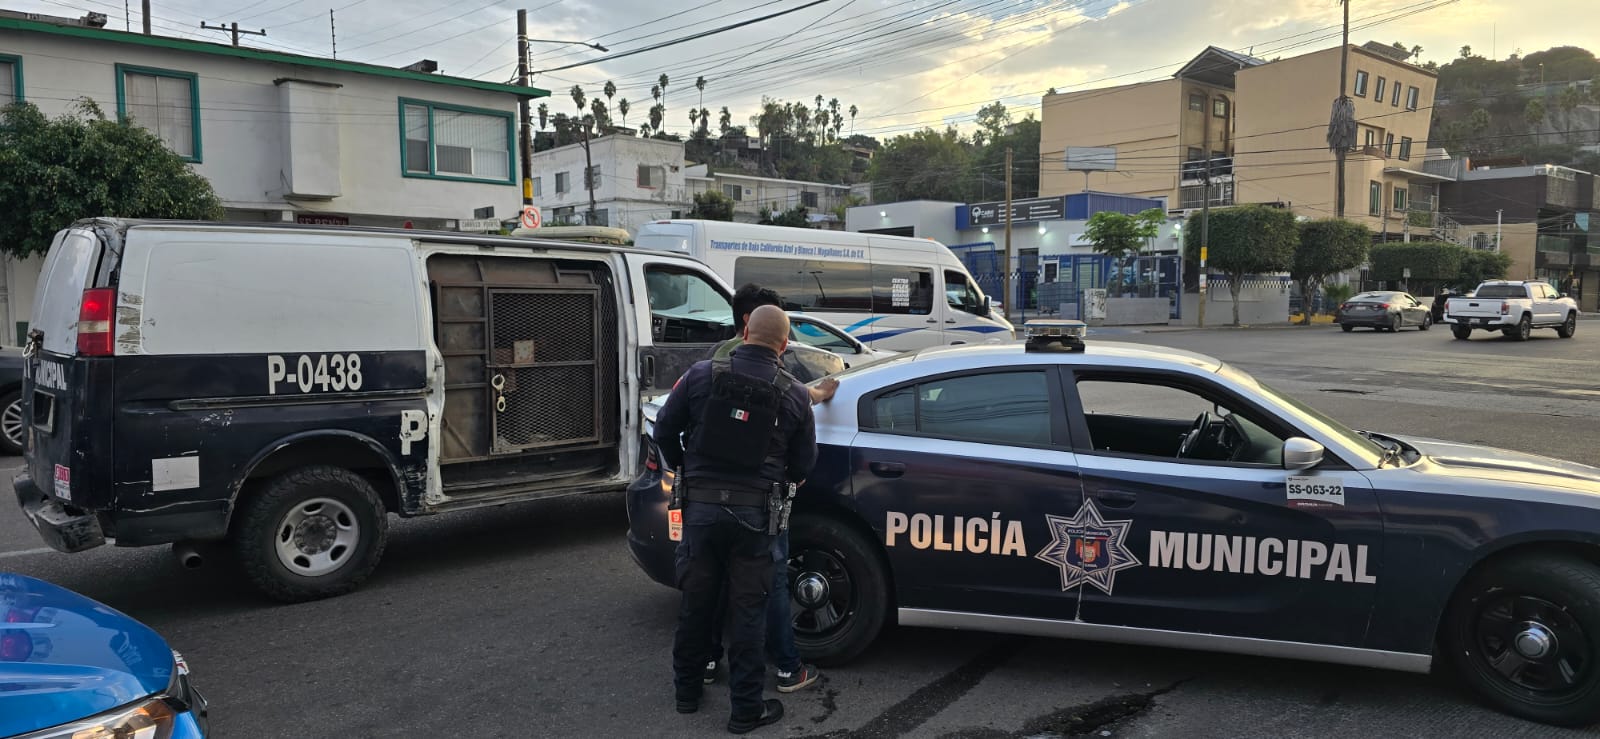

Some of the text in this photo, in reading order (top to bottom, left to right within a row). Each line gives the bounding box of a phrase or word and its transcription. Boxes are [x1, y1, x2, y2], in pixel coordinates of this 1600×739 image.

[710, 239, 741, 251] Transportes
[268, 353, 363, 394] P-0438
[1289, 485, 1342, 496] SS-063-22
[886, 511, 1376, 584] POLICÍA MUNICIPAL
